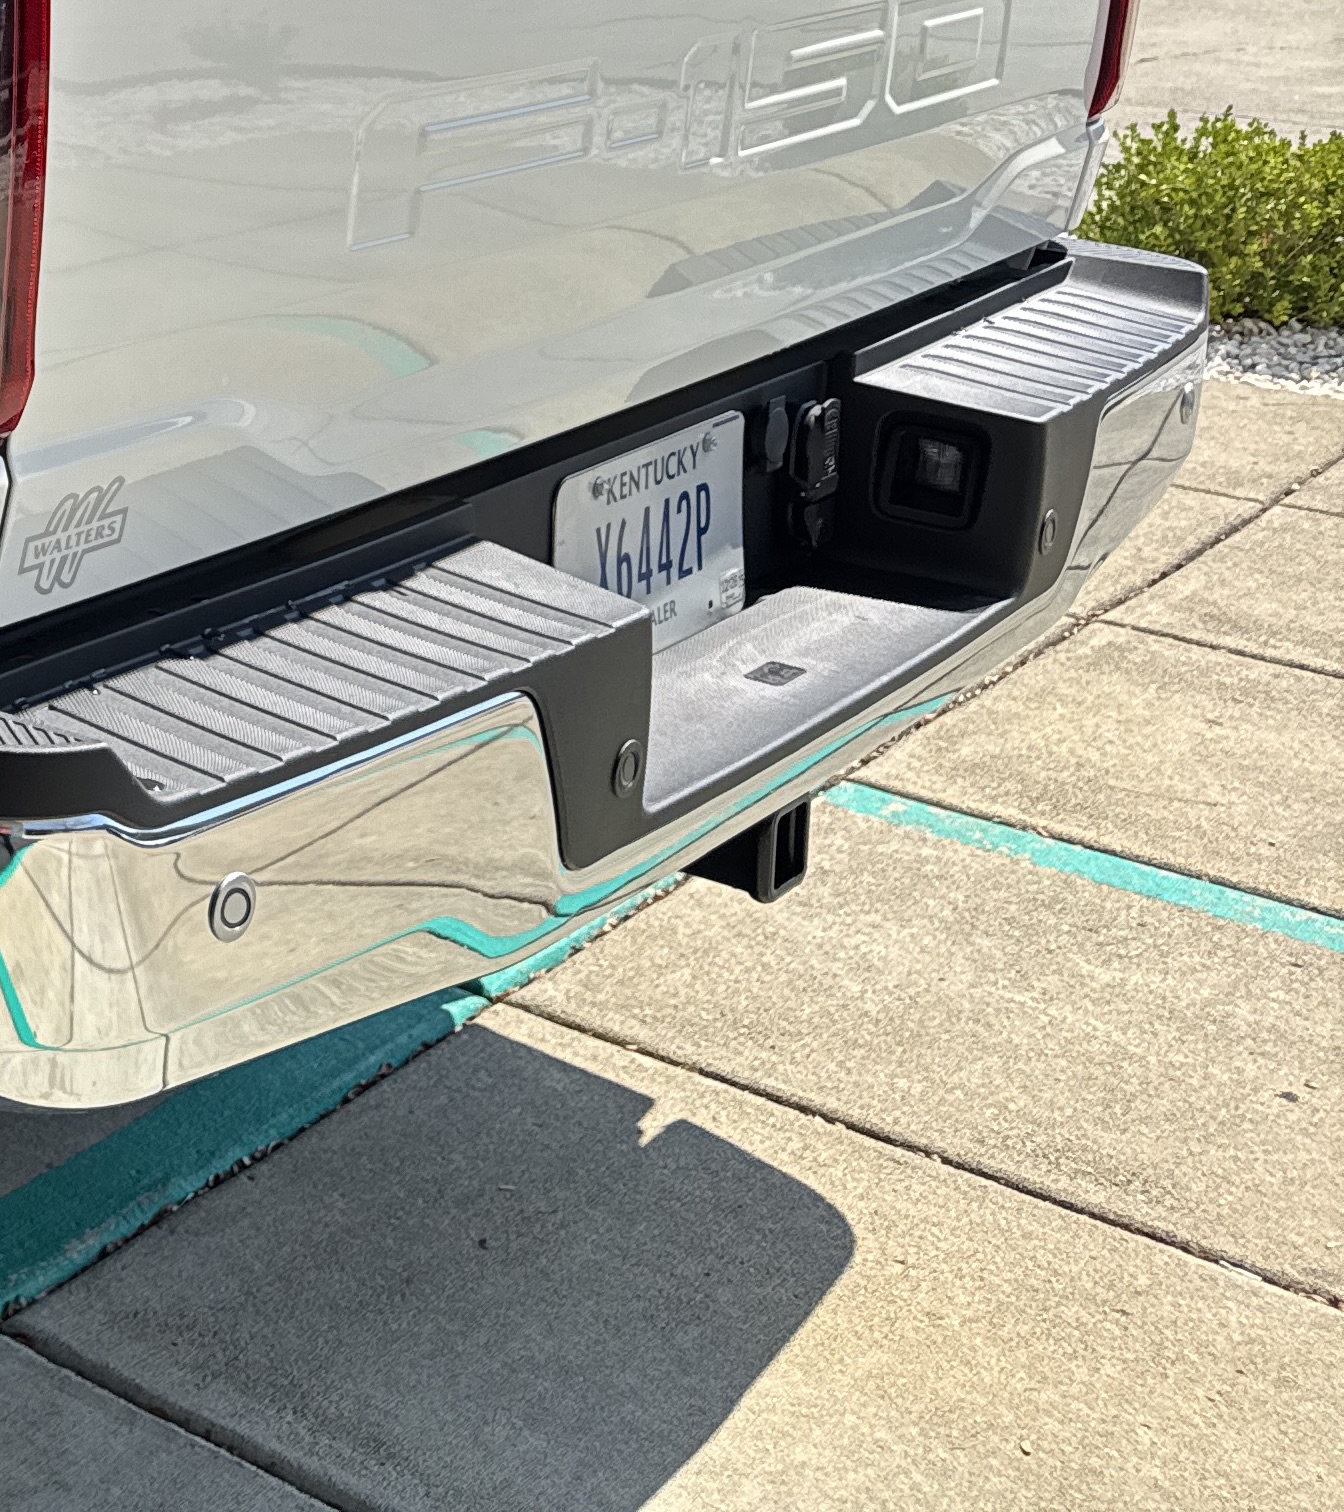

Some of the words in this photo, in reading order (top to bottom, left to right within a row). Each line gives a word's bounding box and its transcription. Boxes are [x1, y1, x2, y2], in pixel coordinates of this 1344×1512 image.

[605, 441, 701, 506] KENTUCKY
[34, 520, 117, 559] WALTERS
[595, 481, 711, 600] X6442P
[651, 599, 678, 626] ALER
